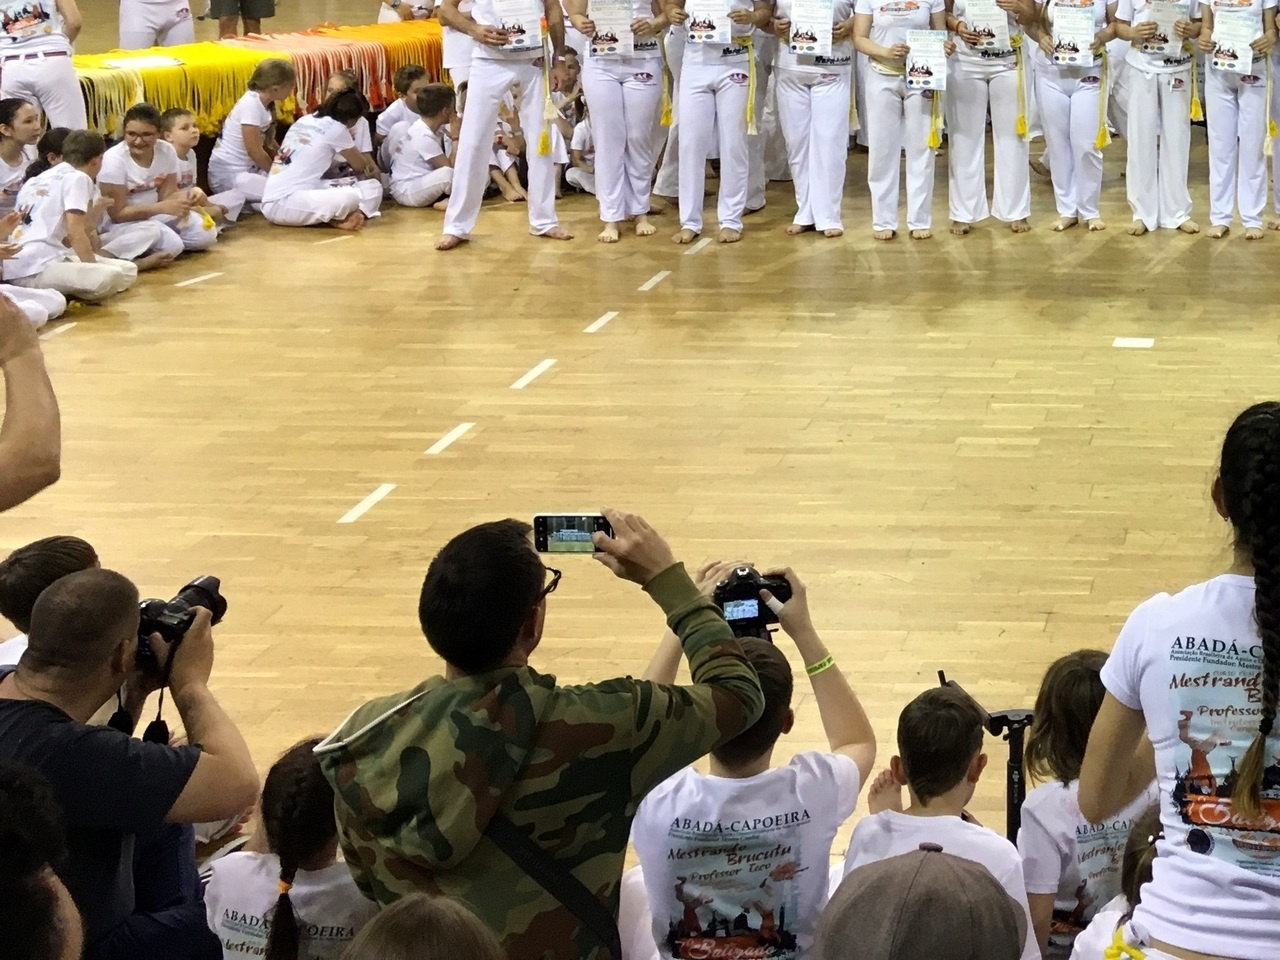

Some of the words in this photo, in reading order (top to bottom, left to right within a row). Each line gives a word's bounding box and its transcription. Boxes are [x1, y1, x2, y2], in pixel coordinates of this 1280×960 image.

[1169, 654, 1202, 663] Presidente
[1169, 671, 1263, 690] Mestrand
[1196, 705, 1264, 717] Professo
[670, 809, 812, 834] ABADÁ-CAPOEIRA
[667, 843, 747, 860] Mestrando
[725, 844, 792, 866] Brucutu
[689, 868, 743, 881] Professor
